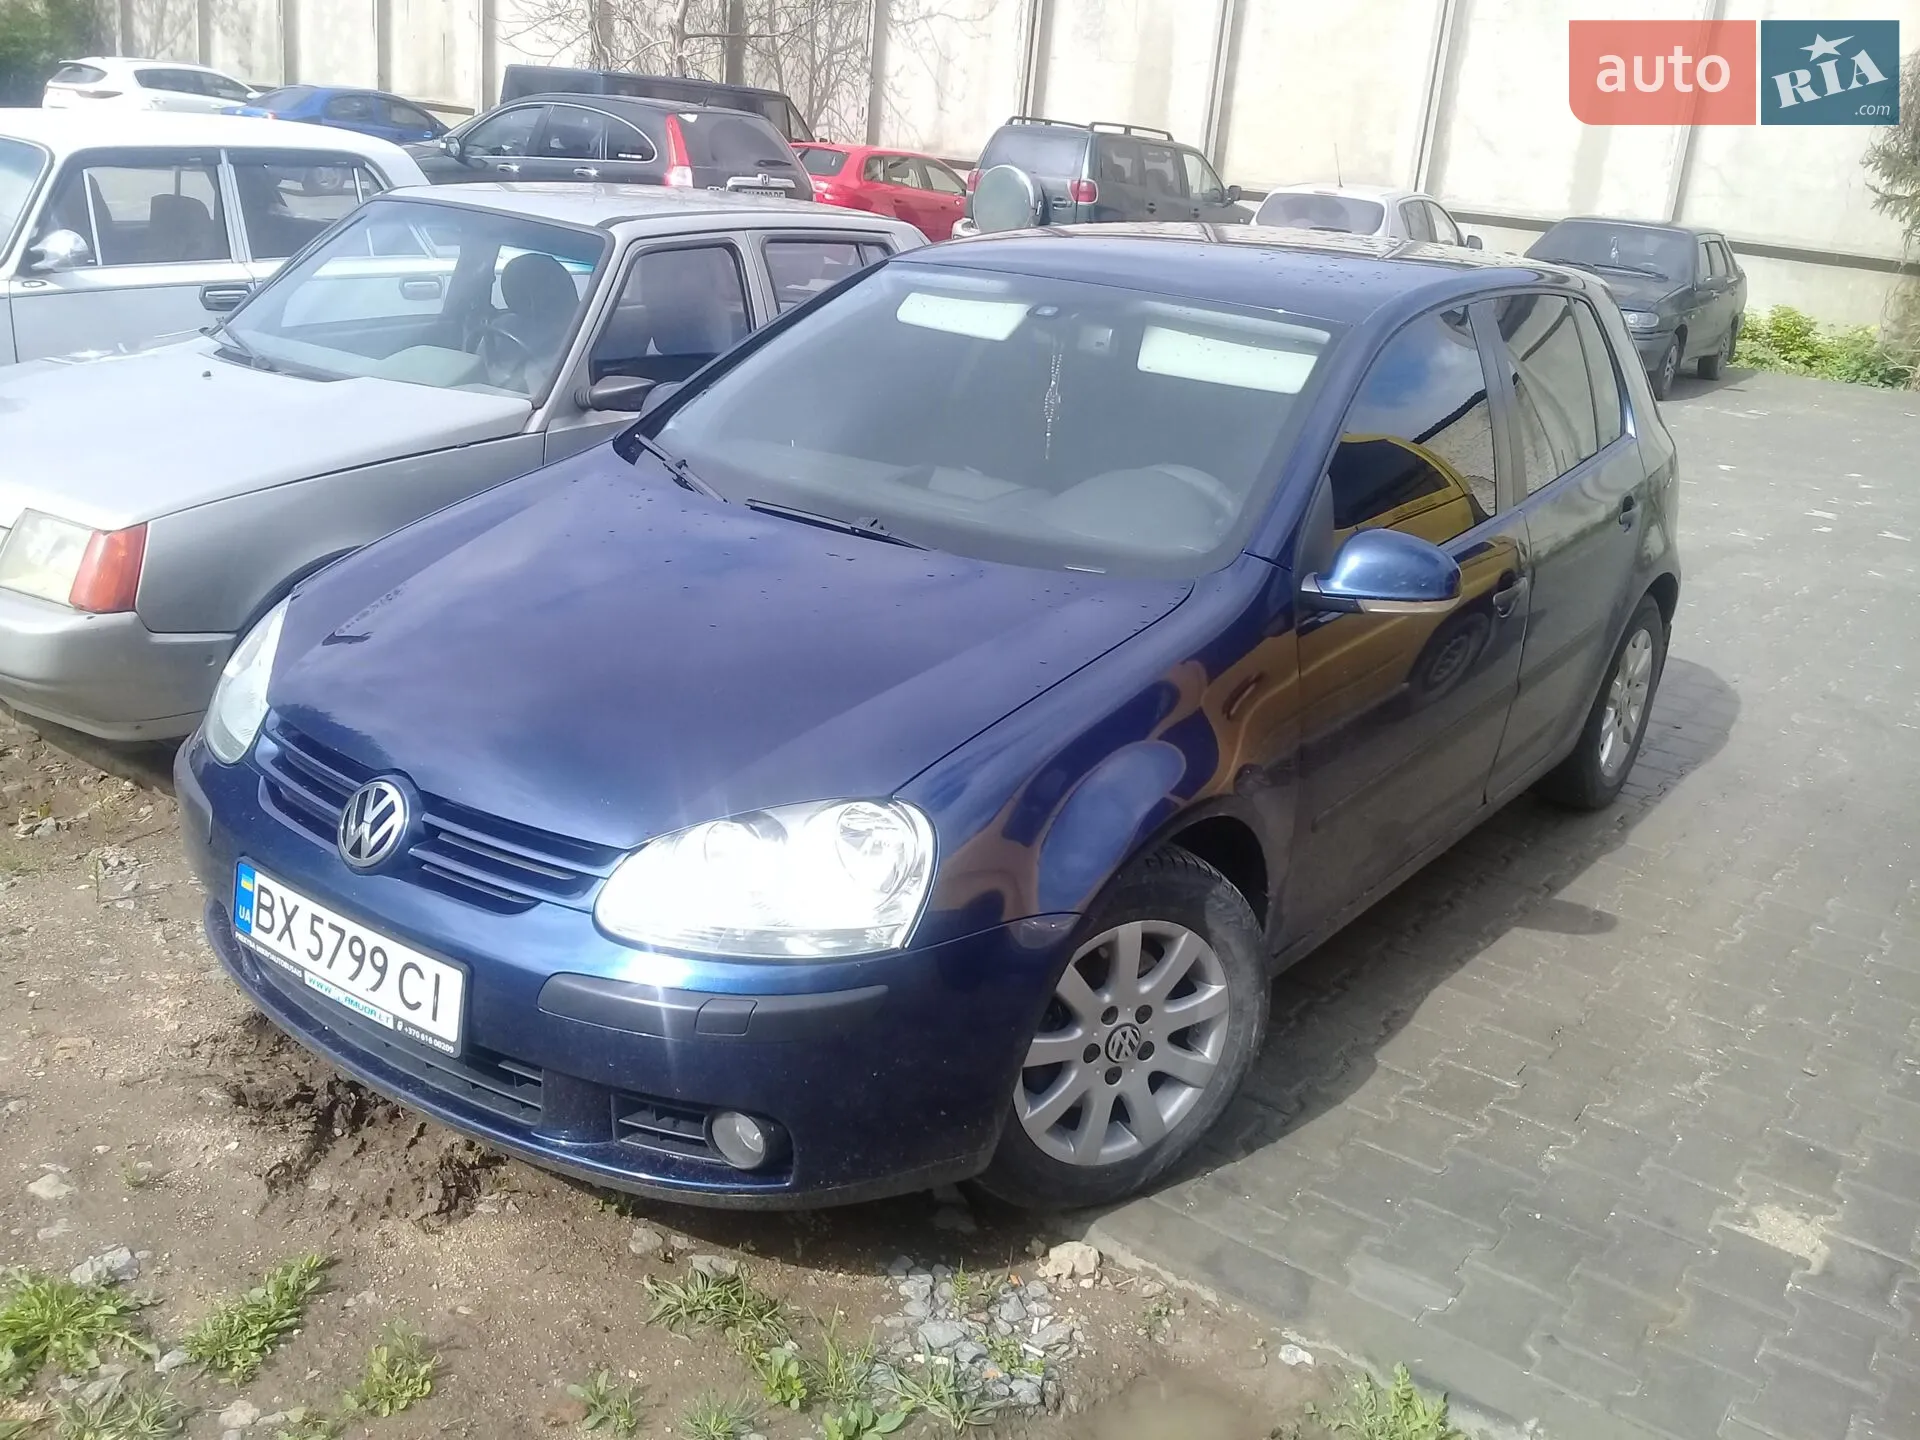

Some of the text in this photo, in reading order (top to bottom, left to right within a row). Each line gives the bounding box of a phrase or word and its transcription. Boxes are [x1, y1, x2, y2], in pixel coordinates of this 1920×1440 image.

[239, 904, 251, 924] UA
[255, 883, 441, 1022] BX 5799 CI
